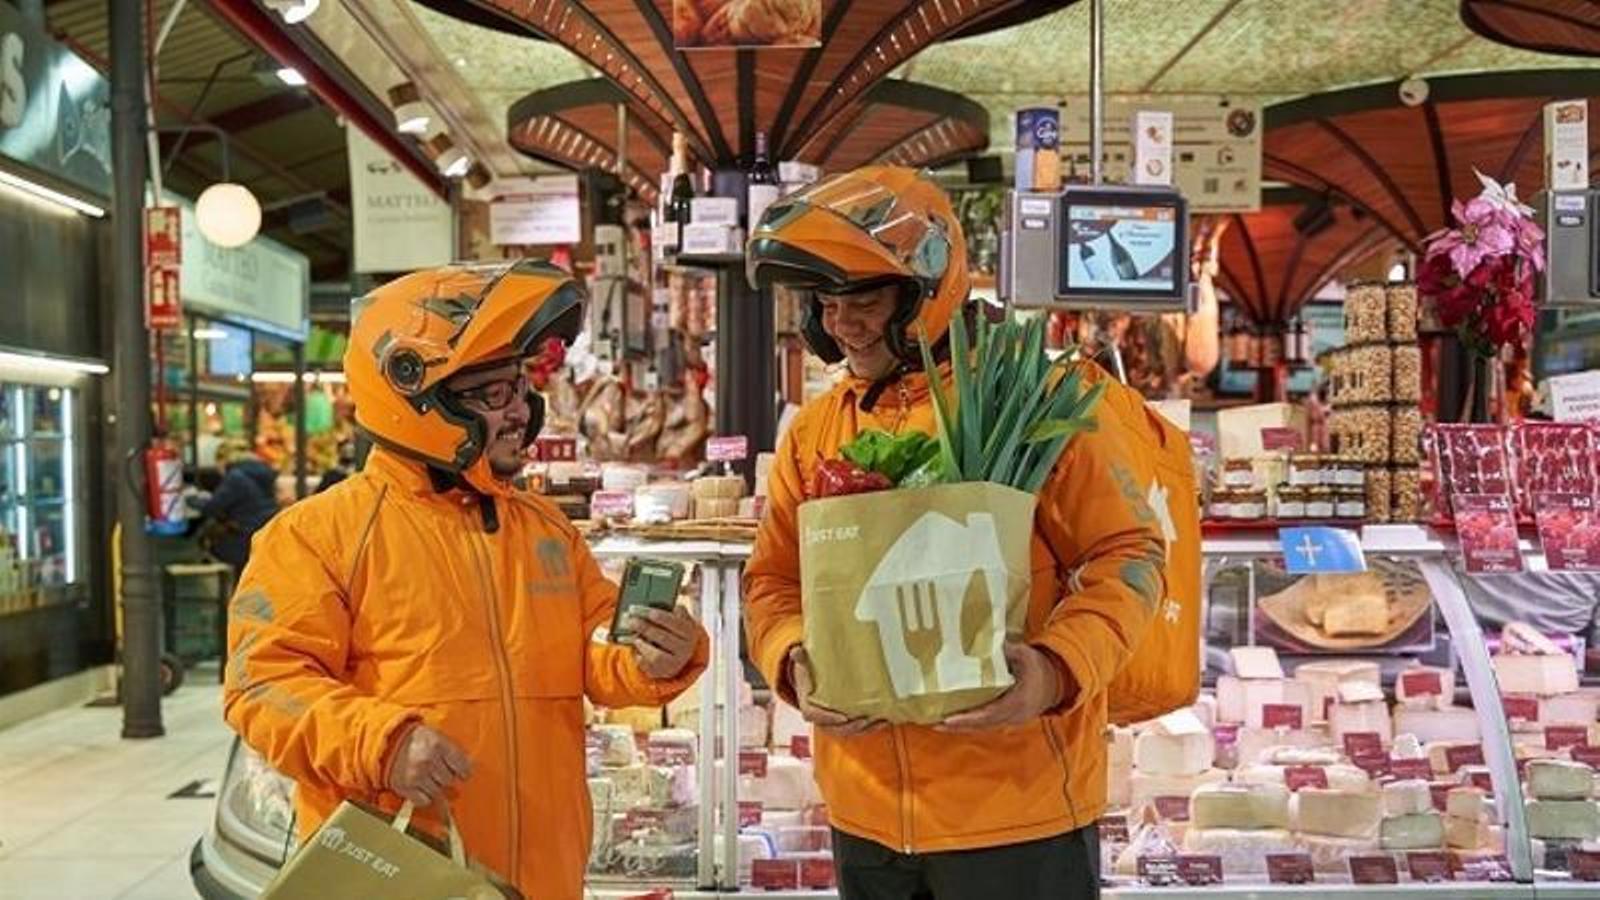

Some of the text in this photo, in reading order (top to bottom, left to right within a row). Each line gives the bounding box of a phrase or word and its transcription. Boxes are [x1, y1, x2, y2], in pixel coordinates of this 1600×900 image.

[835, 526, 860, 541] EAT
[339, 842, 400, 877] JUST EAT
